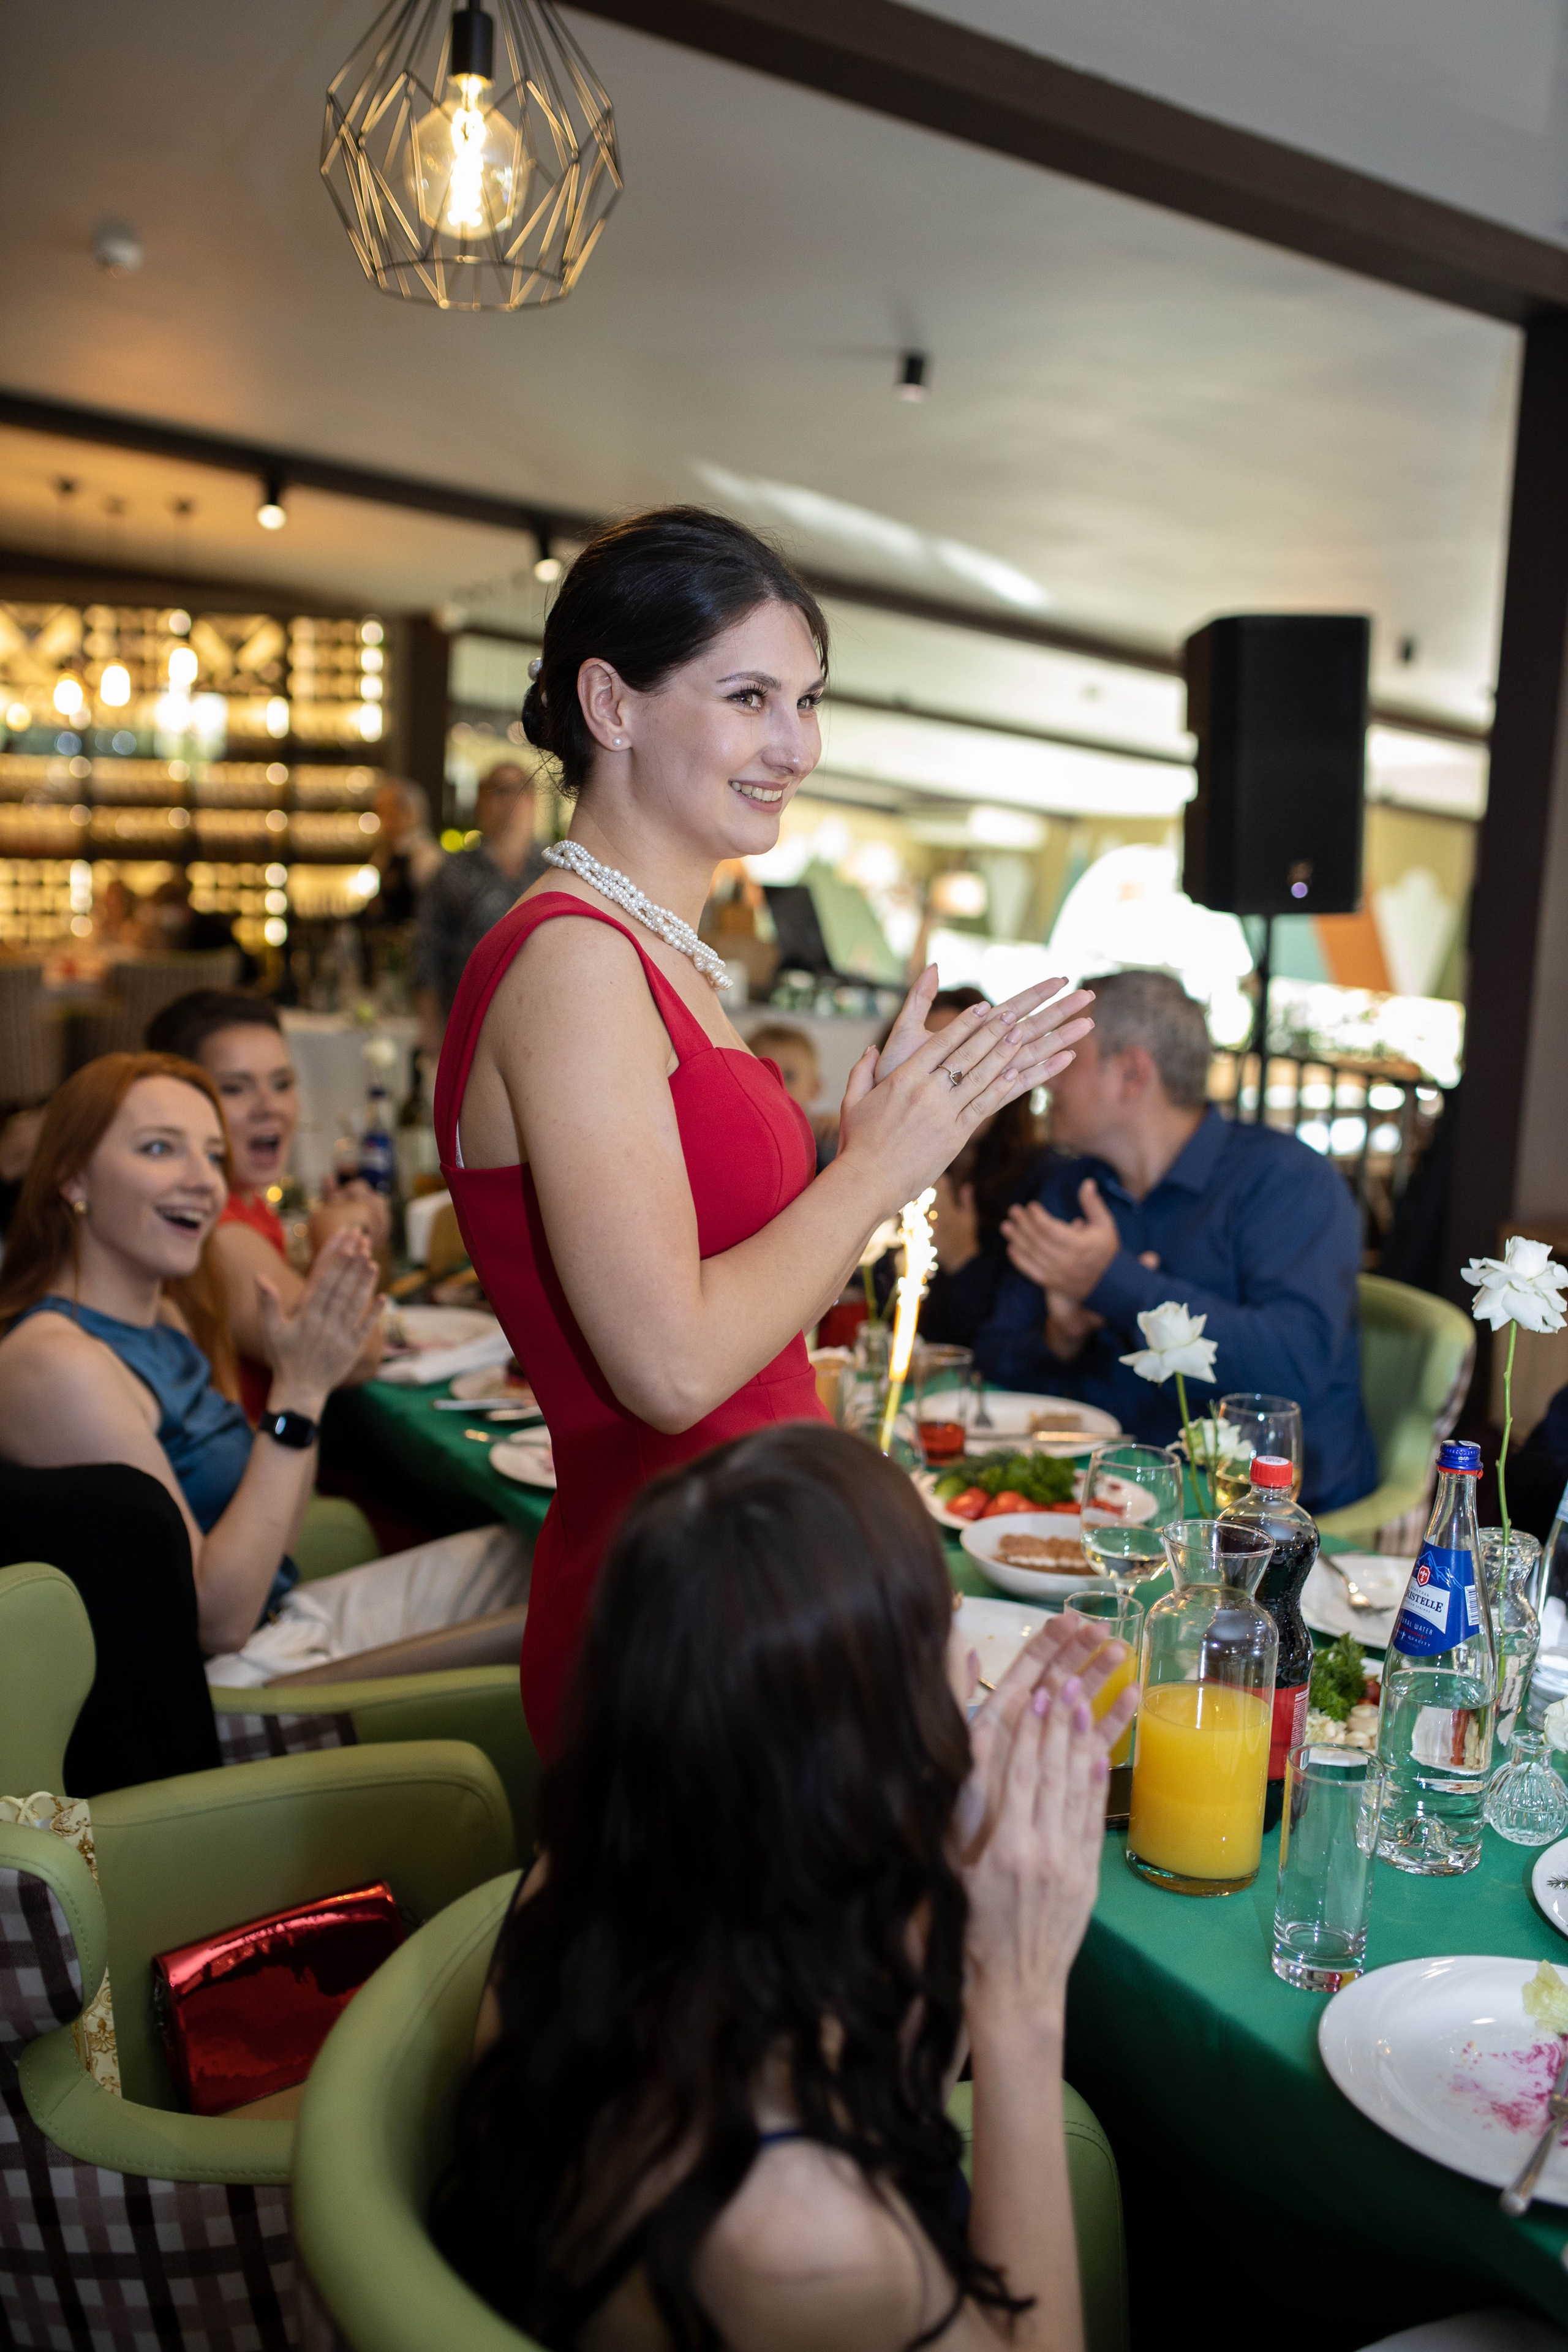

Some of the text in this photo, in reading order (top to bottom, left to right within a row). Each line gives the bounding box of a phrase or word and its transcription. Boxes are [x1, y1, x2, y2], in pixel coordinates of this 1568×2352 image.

[1405, 1589, 1444, 1613] RISTELLE
[1414, 1623, 1434, 1636] WATER
[1408, 1635, 1431, 1648] QUALITY
